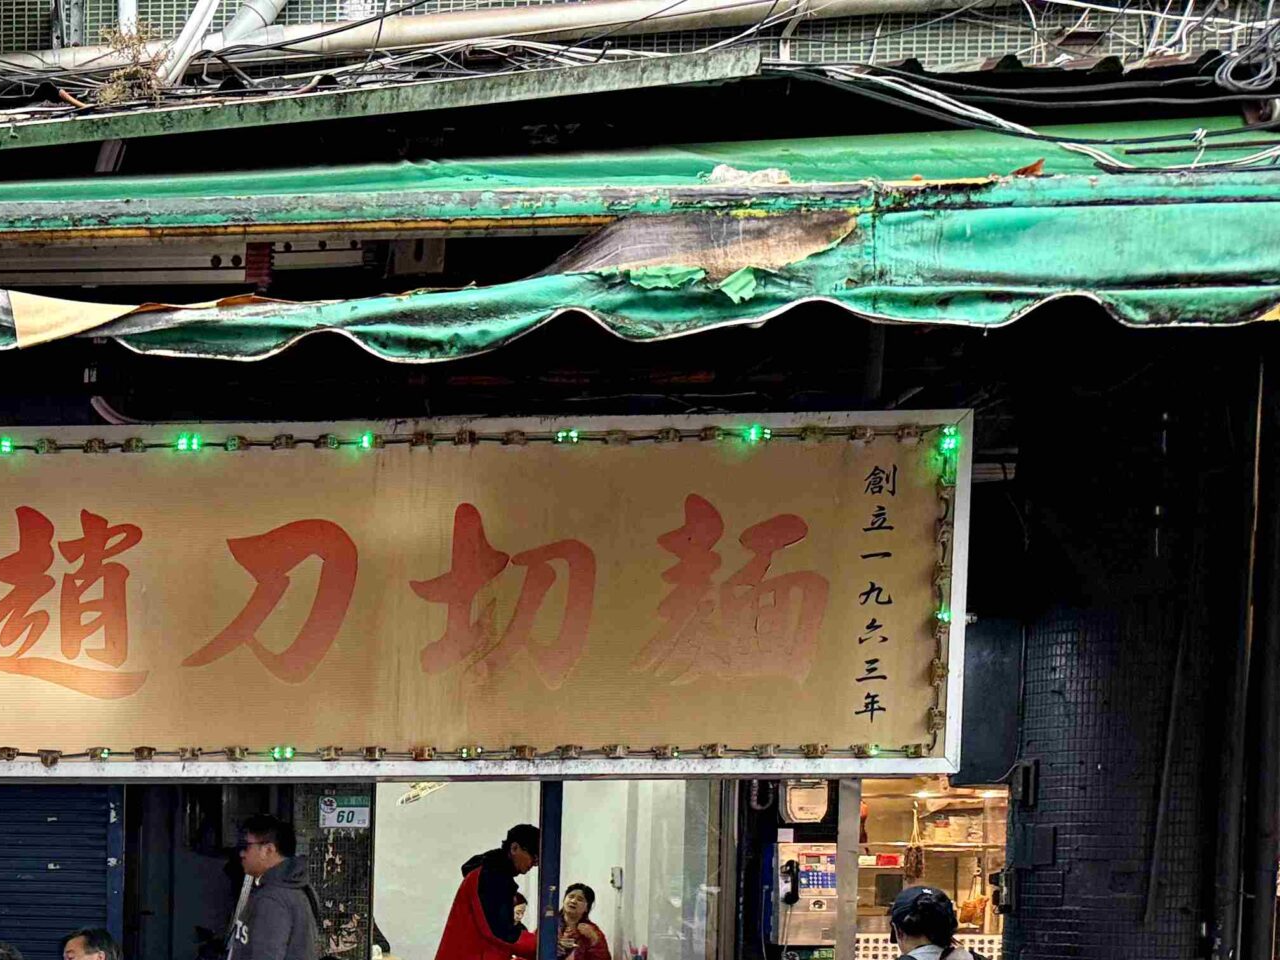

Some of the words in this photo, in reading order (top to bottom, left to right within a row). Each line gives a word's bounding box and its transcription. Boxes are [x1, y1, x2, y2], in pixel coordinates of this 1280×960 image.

[854, 464, 898, 723] 創立一九六三年
[336, 810, 355, 824] 60
